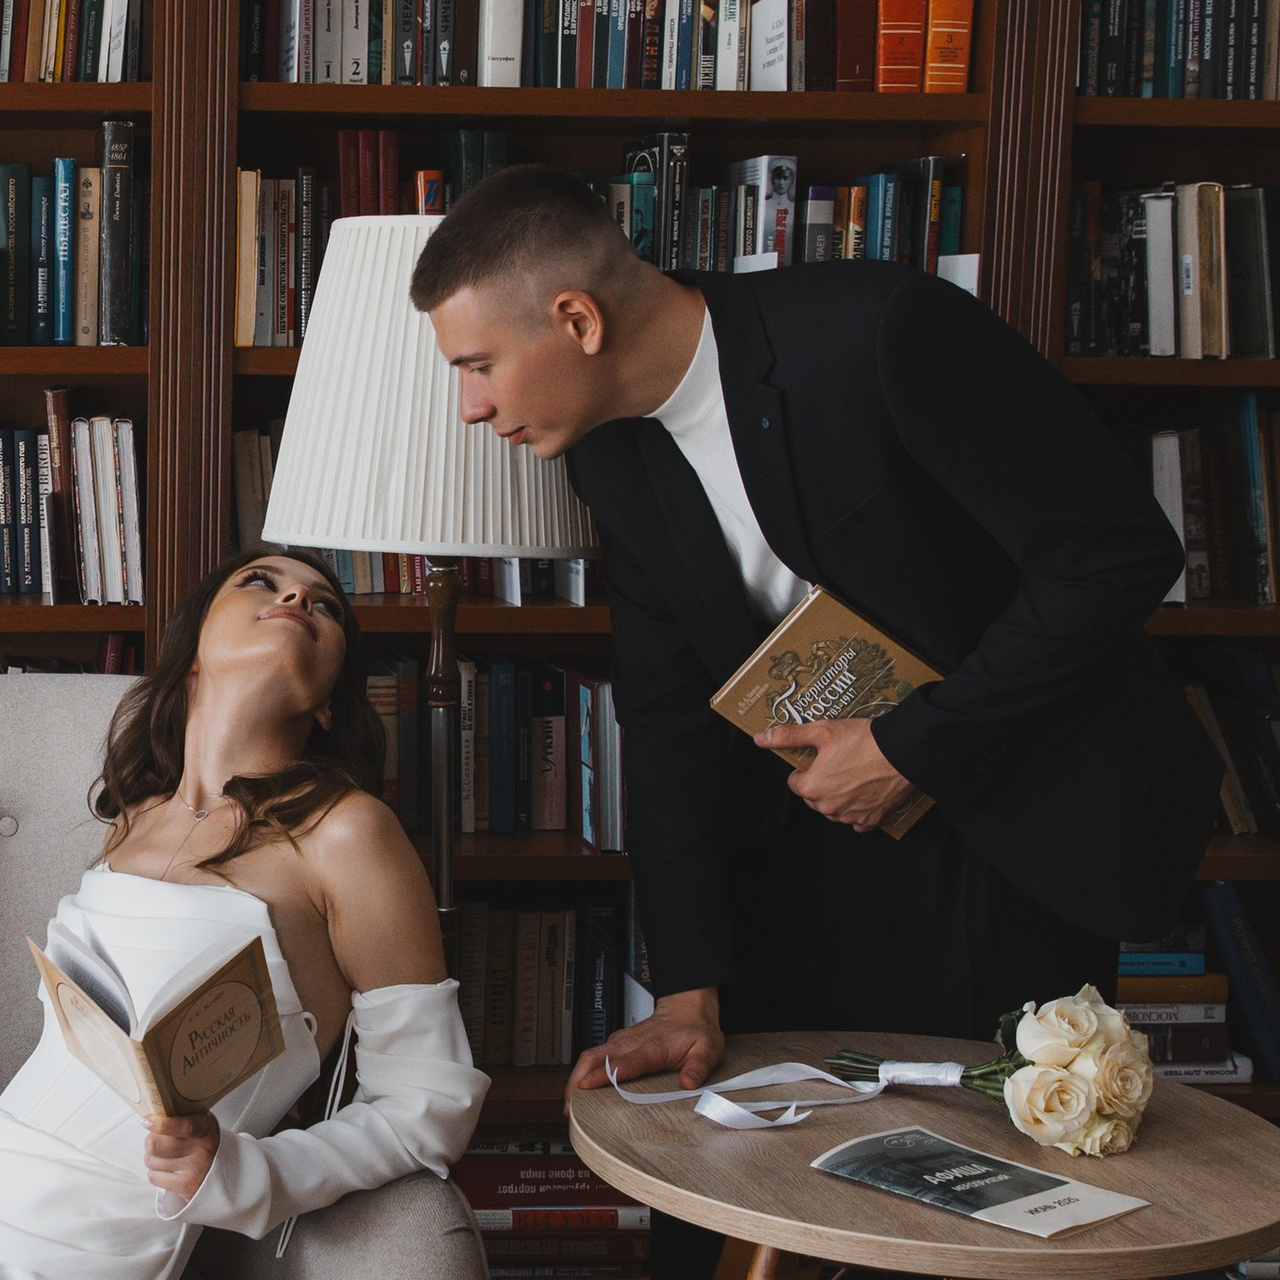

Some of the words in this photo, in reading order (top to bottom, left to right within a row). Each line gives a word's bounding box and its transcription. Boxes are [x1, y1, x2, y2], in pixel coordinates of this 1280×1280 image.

[351, 61, 360, 75] 2
[701, 54, 714, 87] ЛЕНИН
[885, 182, 894, 216] КРАСНЫХ
[930, 180, 941, 222] ПУСТЫНИ
[60, 182, 69, 261] ПЬЕДЕСТАЛ
[883, 220, 892, 246] ПРОТИВ
[38, 443, 49, 485] ВЕКОВ
[772, 648, 857, 725] Губернаторы
[804, 670, 857, 722] РОССИИ
[183, 1012, 251, 1076] АНТИЧНОСТЬ
[188, 1006, 236, 1050] РУССКАЯ
[923, 1163, 995, 1185] АФИША
